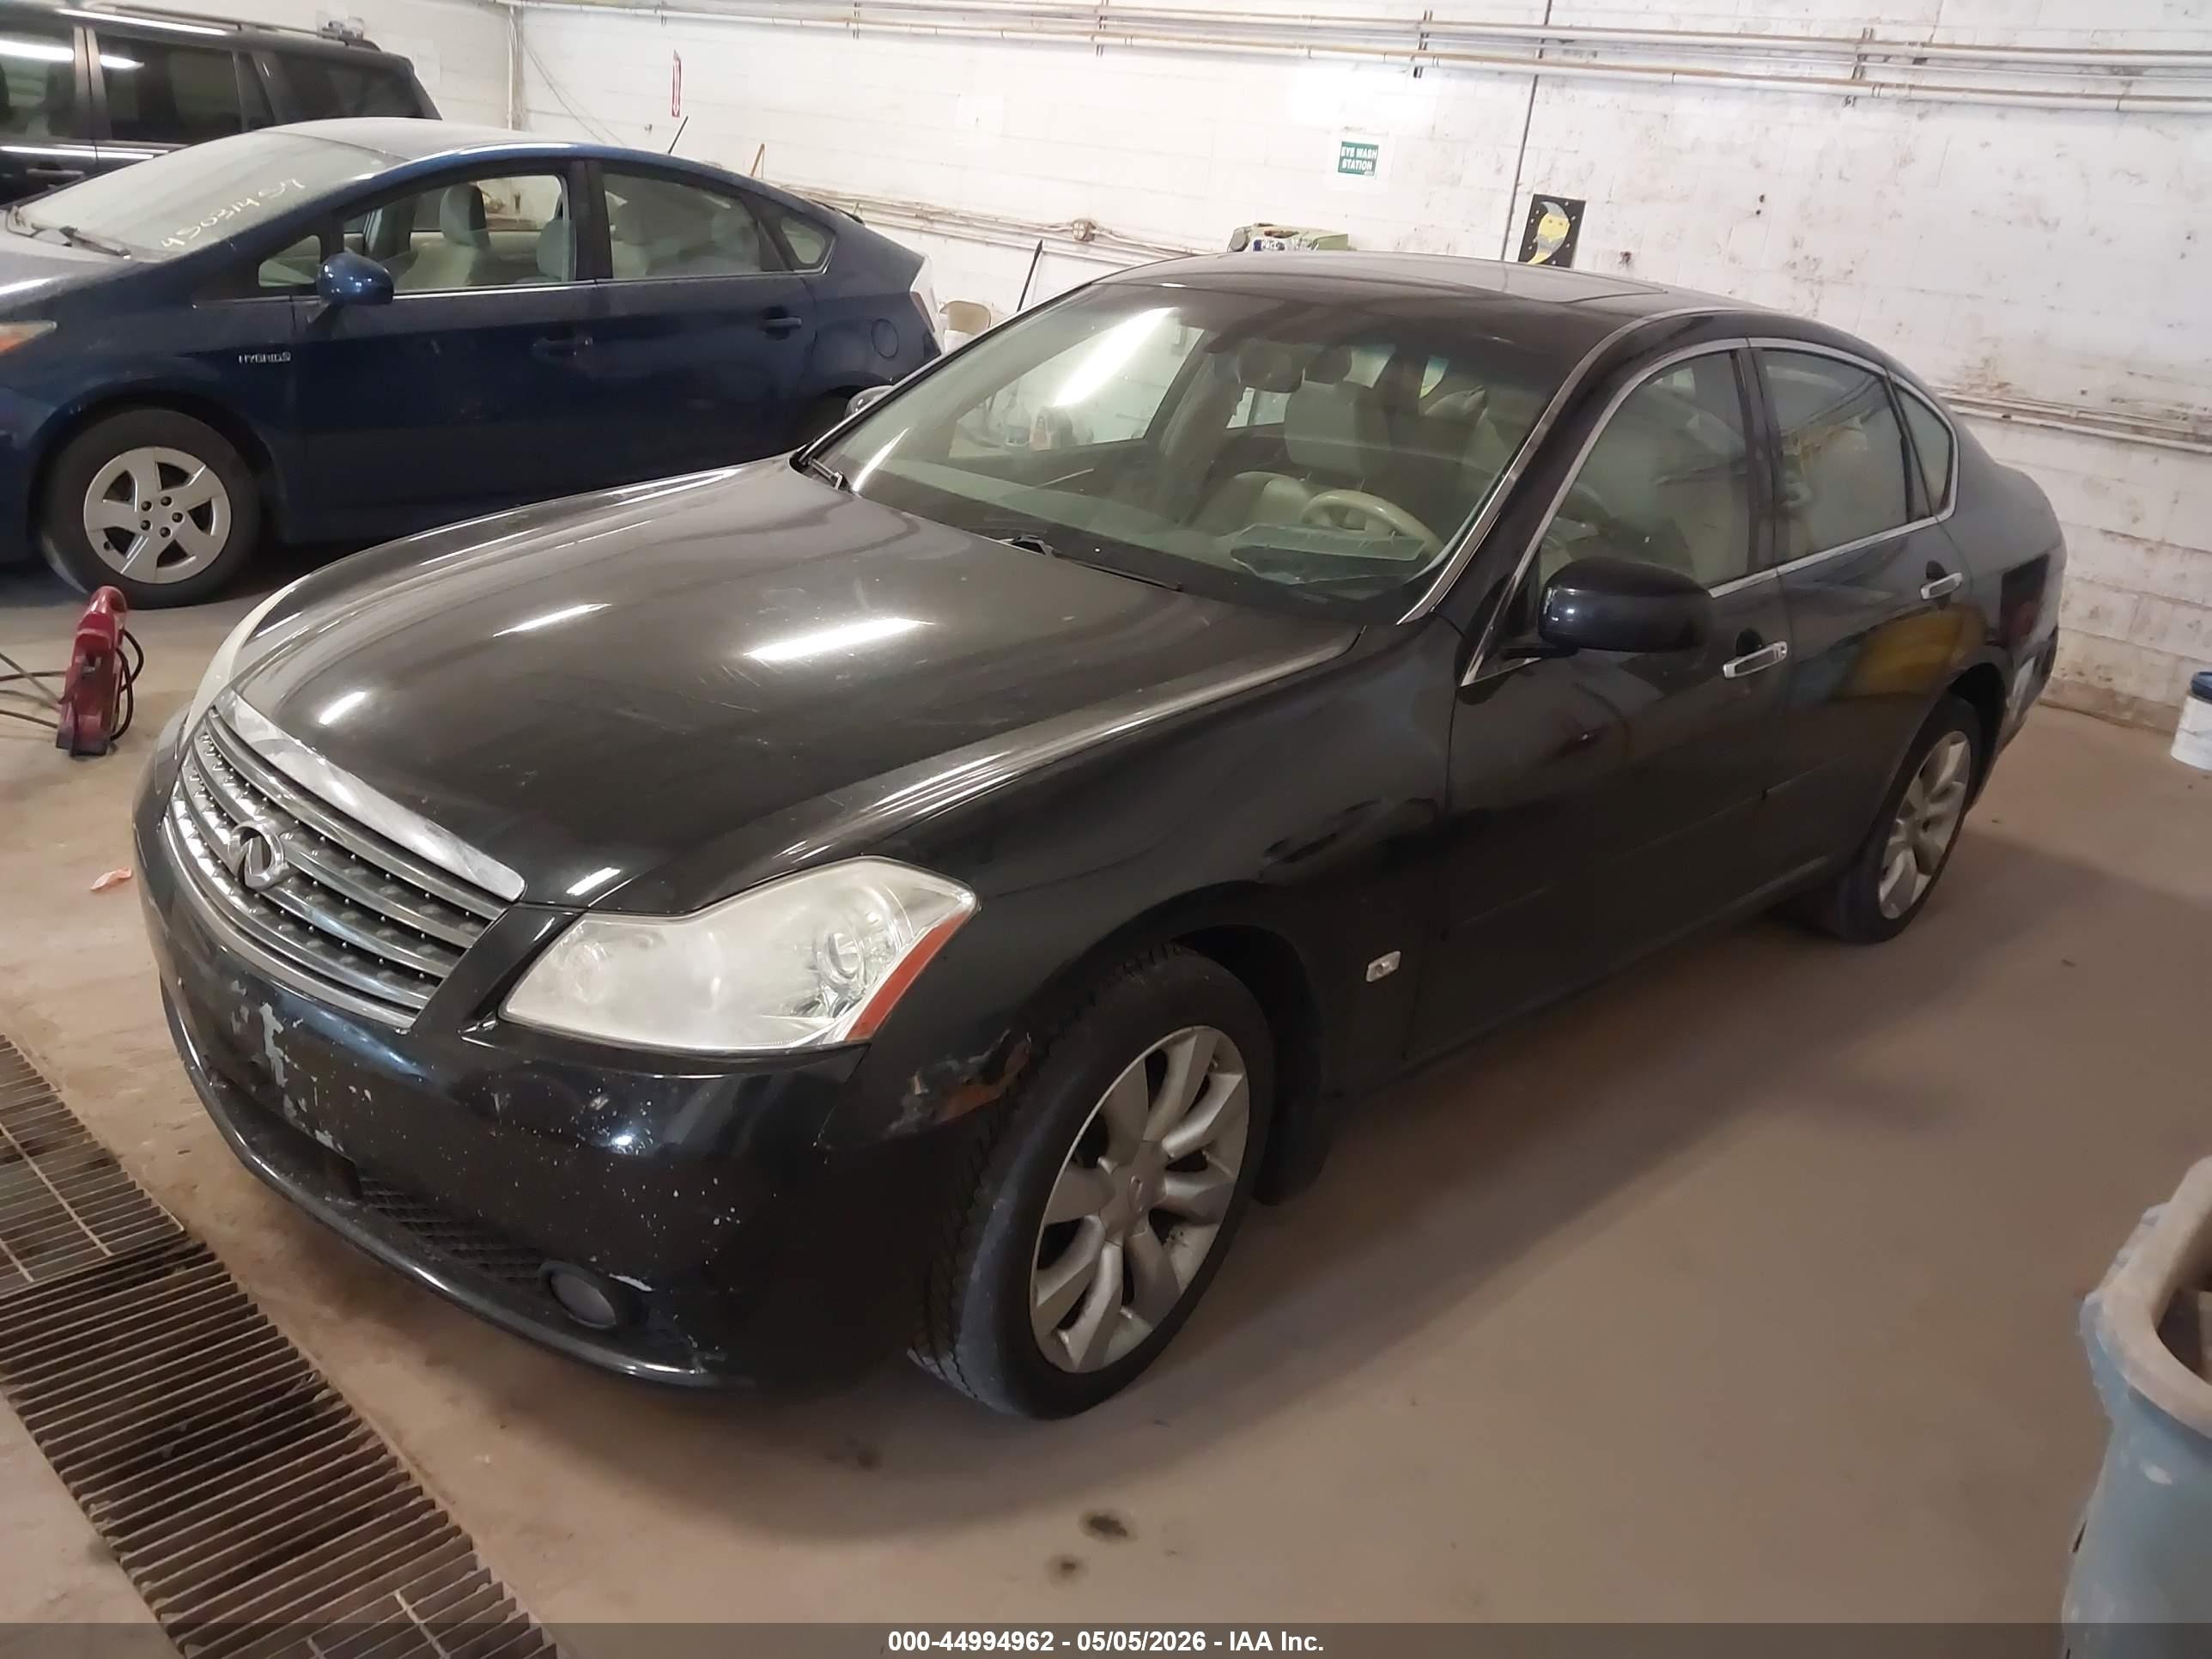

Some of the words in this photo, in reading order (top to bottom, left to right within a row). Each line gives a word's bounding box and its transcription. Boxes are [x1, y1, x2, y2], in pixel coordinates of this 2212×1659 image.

[1340, 145, 1355, 158] EYE
[1356, 147, 1377, 160] WASH
[1341, 157, 1373, 173] STATION
